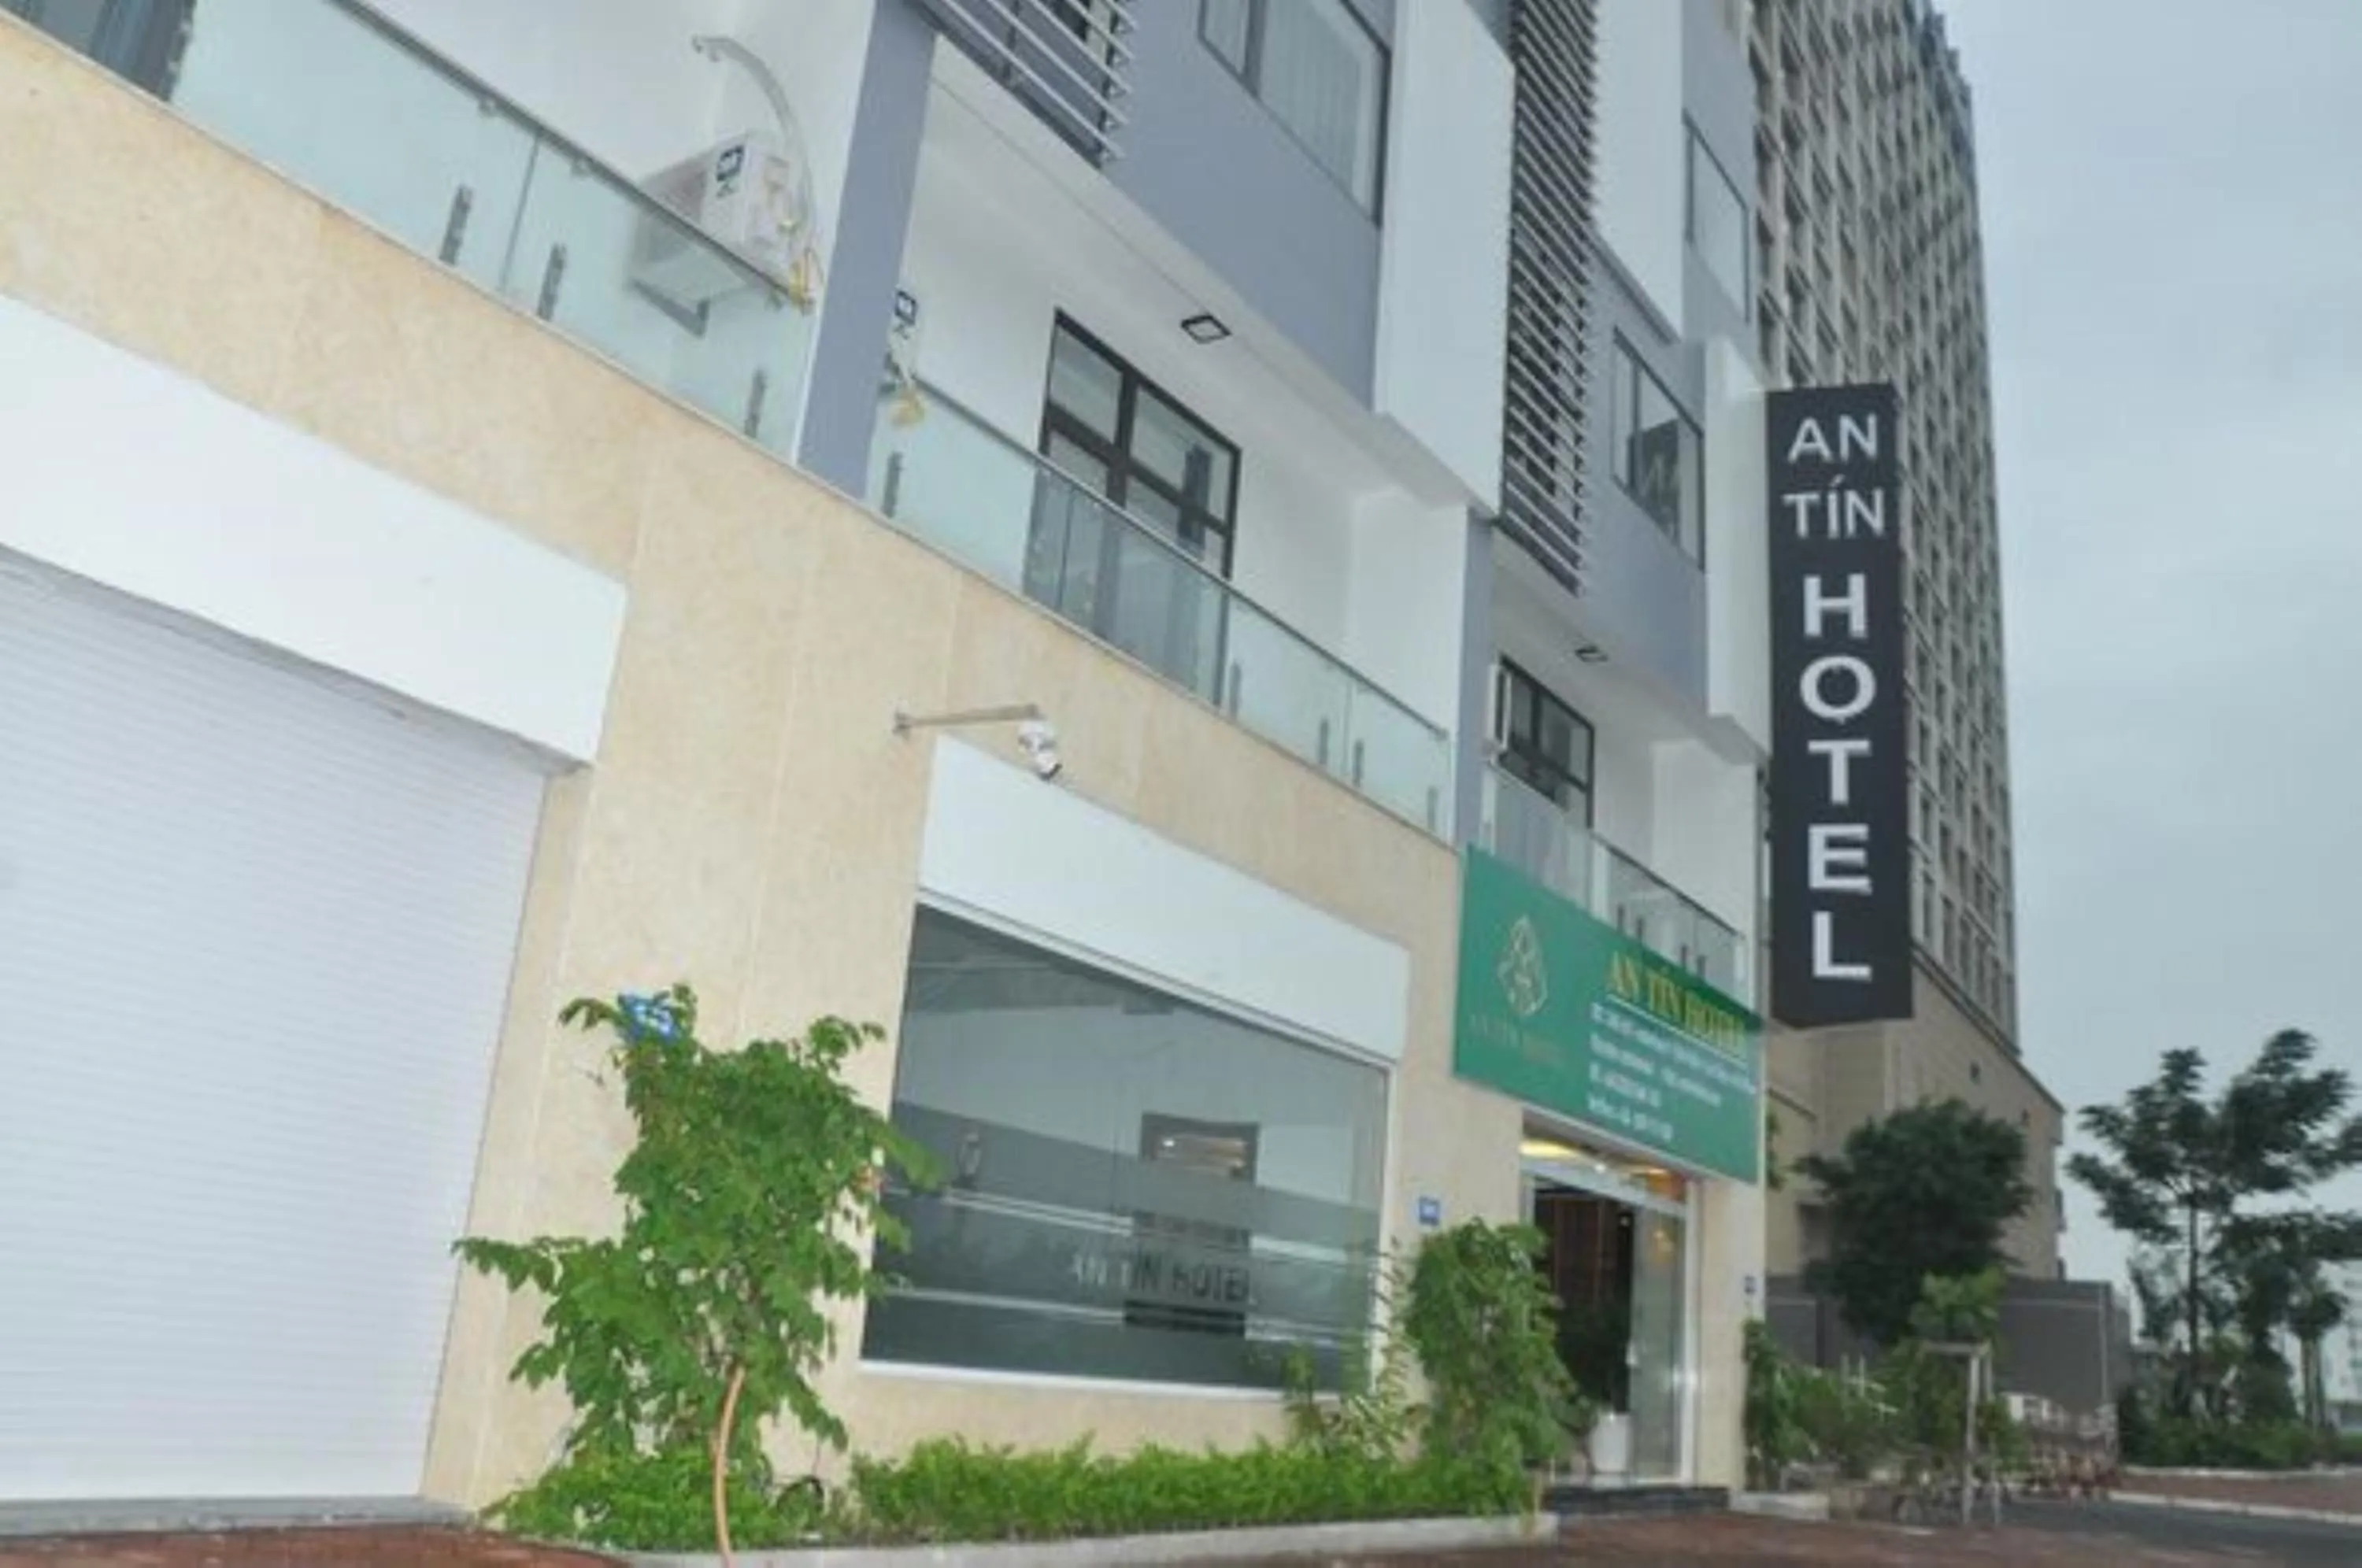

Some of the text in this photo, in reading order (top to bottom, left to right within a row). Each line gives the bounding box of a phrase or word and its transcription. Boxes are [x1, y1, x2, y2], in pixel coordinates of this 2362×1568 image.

[1787, 412, 1879, 463] AN
[1783, 474, 1885, 540] TÍN
[1799, 572, 1877, 982] HOTEL
[1605, 950, 1641, 1004] AN
